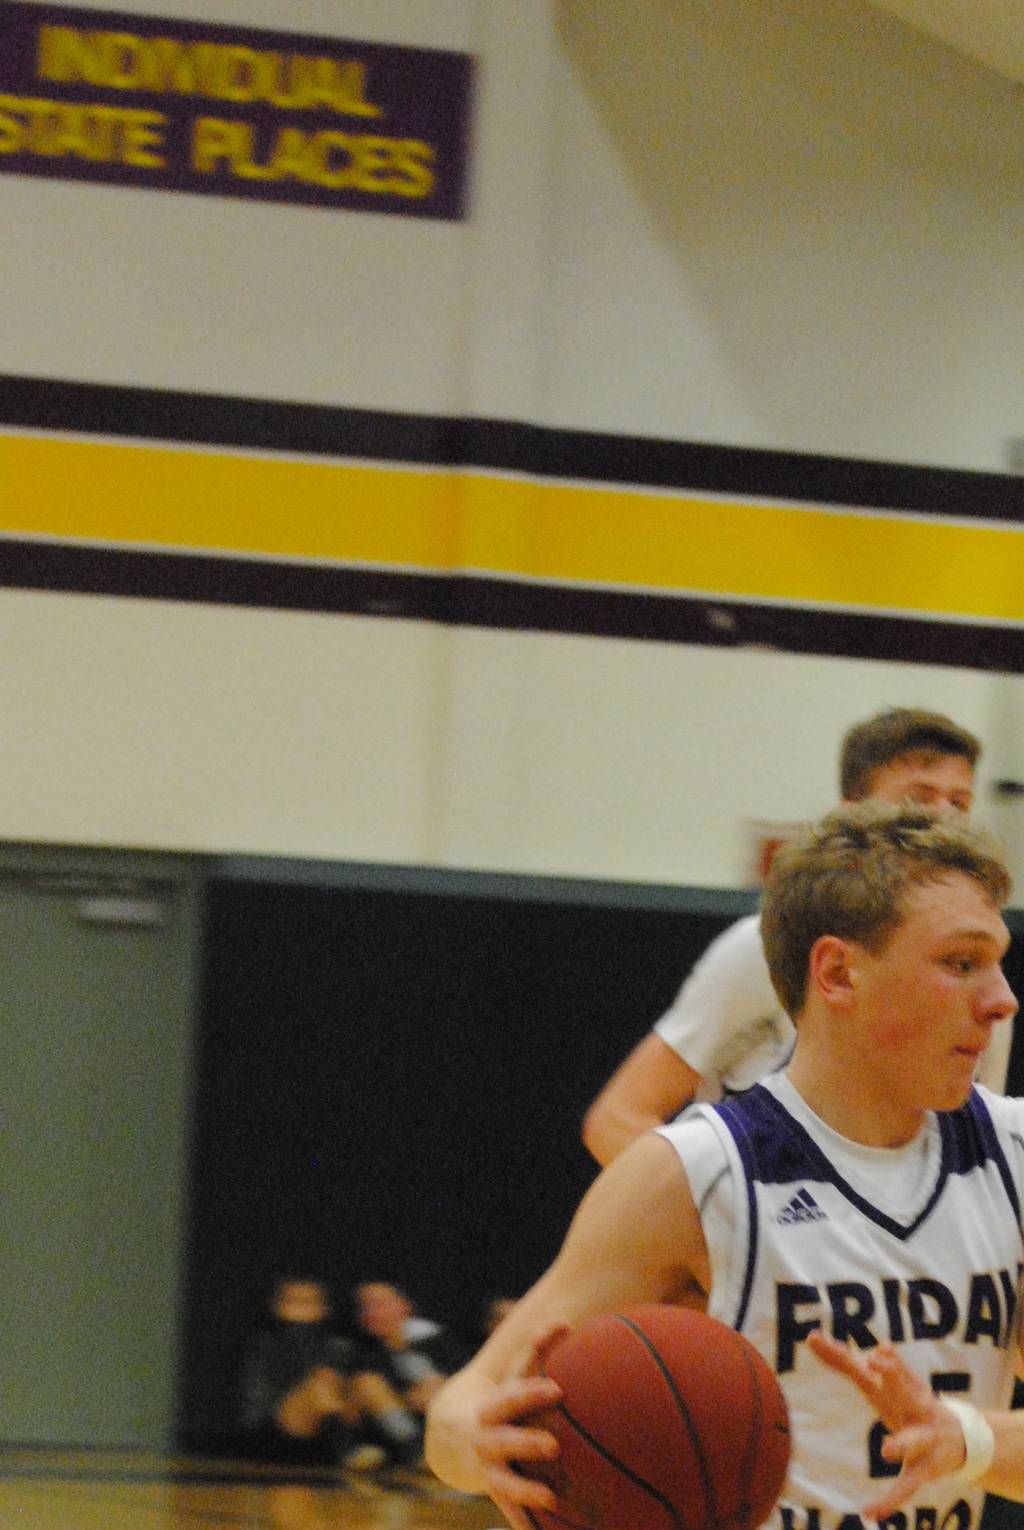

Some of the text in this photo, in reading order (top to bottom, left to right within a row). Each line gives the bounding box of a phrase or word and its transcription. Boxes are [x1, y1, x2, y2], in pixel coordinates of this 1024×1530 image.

[38, 24, 383, 118] INDIVIDUAL
[0, 93, 436, 198] STATE PLACES
